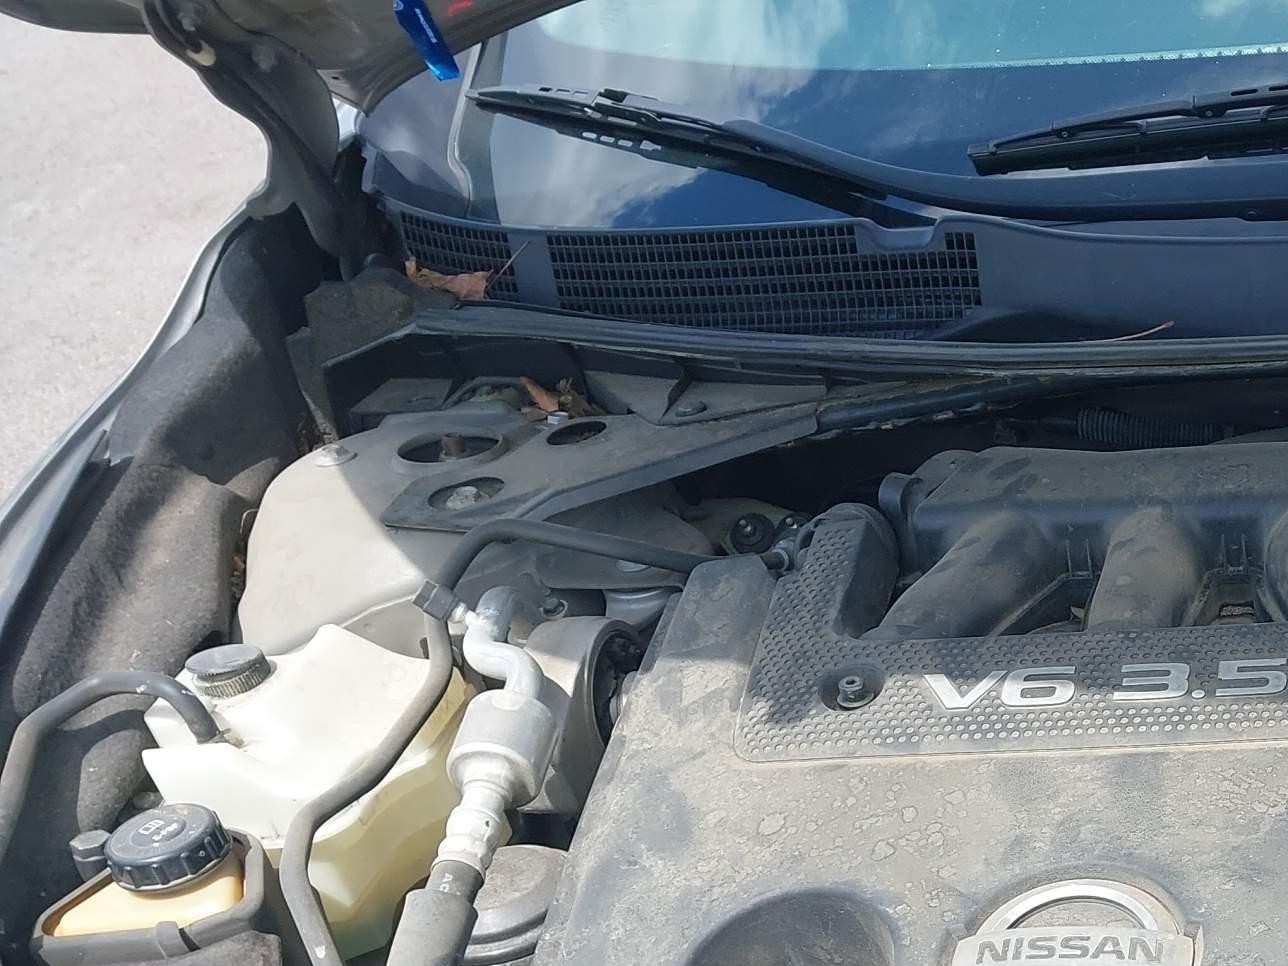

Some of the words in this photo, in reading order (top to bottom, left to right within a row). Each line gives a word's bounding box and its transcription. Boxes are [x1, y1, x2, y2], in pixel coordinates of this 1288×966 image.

[924, 666, 1077, 710] V6
[1113, 657, 1288, 701] 3.5
[976, 935, 1164, 965] NISSAN
